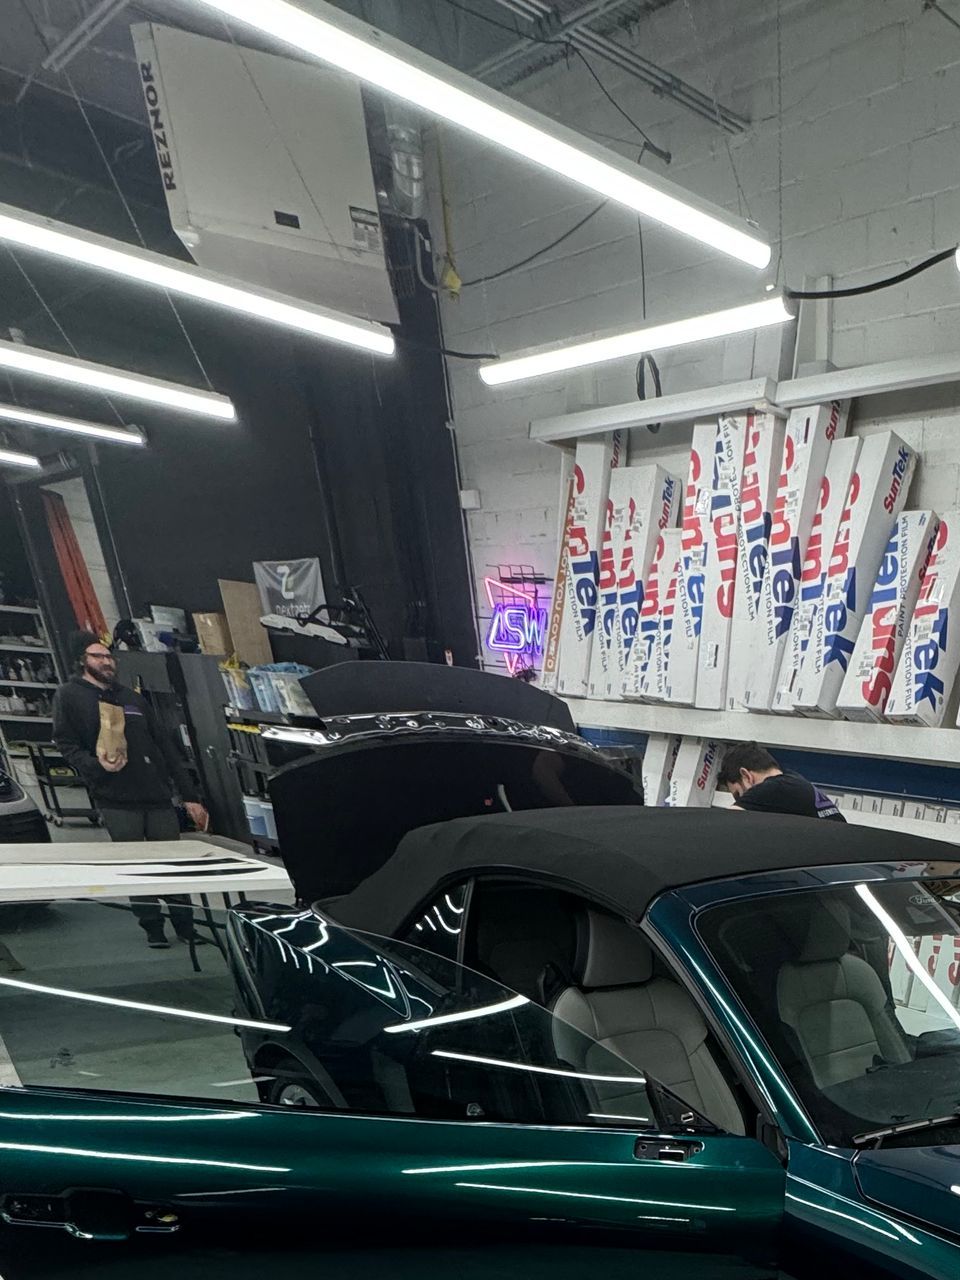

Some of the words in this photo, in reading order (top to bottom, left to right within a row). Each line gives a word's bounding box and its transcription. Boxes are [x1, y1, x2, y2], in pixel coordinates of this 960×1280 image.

[140, 60, 177, 190] REZNOR
[884, 446, 909, 514] SunTek
[659, 476, 674, 530] SunTek
[901, 515, 909, 538] FILM
[555, 582, 565, 611] YOU
[747, 595, 755, 622] FILM
[574, 620, 584, 642] FILM
[767, 619, 775, 646] FILM
[897, 602, 906, 639] PAINT
[600, 651, 608, 673] FILM
[617, 650, 625, 673] FILM
[814, 649, 822, 675] FILM
[696, 742, 717, 791] SunTek
